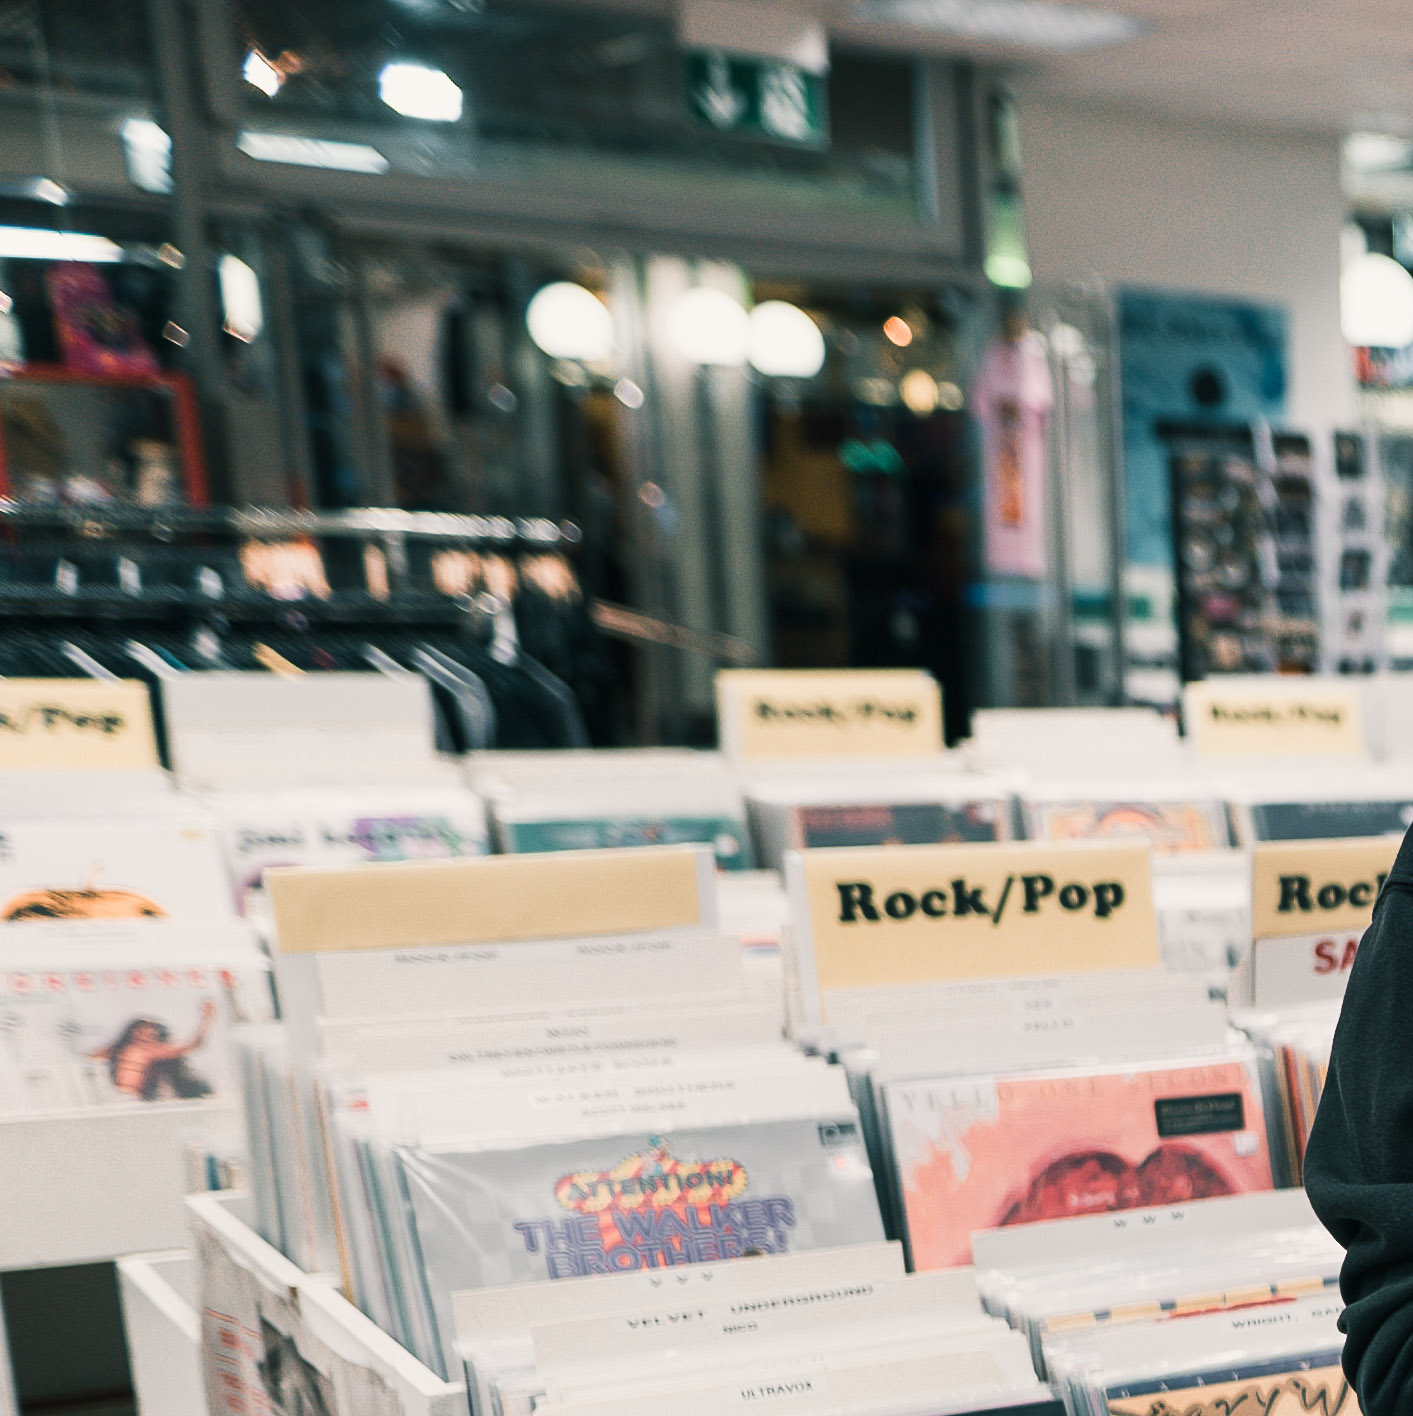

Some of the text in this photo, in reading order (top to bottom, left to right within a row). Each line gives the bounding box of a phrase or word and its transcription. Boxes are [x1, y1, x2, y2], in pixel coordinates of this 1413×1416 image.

[836, 872, 1127, 925] Rock/Pop
[567, 1167, 734, 1202] ATTENTION!
[513, 1194, 797, 1257] THE WALKER
[627, 1284, 875, 1330] VELVET UNDERGROUND
[741, 1379, 814, 1400] ULTRAVOX
